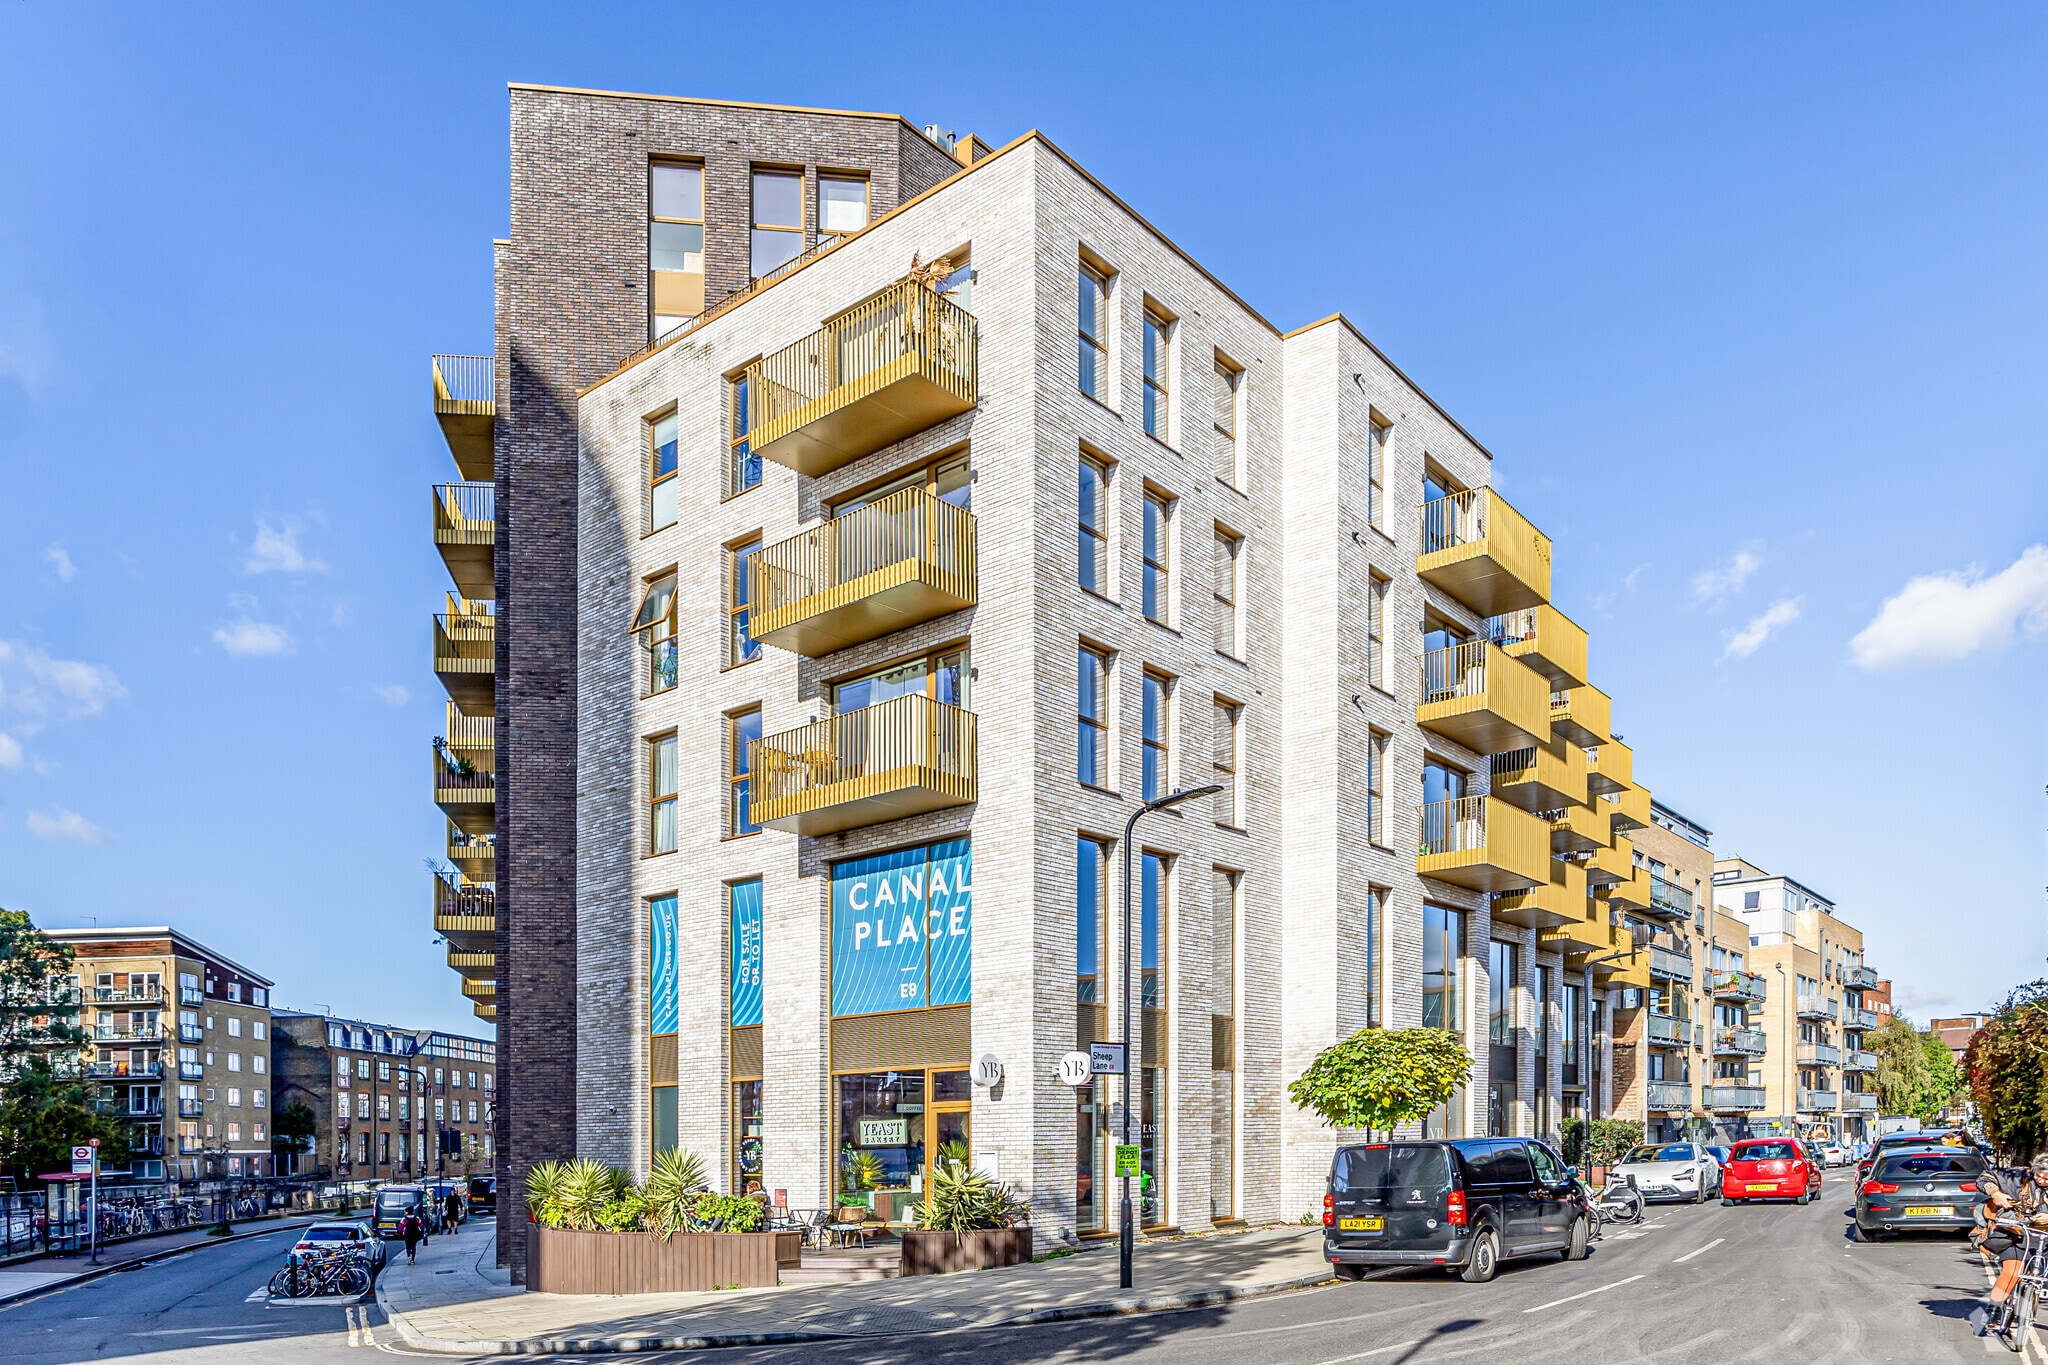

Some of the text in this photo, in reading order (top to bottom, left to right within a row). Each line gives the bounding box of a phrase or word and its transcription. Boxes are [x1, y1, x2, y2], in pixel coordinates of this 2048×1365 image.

[849, 864, 972, 911] CANAL
[854, 905, 966, 951] PLACE
[741, 922, 750, 985] FOR SALE
[751, 918, 760, 986] OR TO LET
[900, 982, 917, 998] E8
[1093, 1052, 1113, 1061] Sheep
[981, 1062, 999, 1078] YB
[1063, 1060, 1085, 1077] YB
[1092, 1061, 1108, 1070] Lane
[862, 1122, 902, 1136] YEAST
[864, 1136, 900, 1144] BAKERY
[745, 1150, 757, 1161] YB
[1362, 1220, 1377, 1228] YSR
